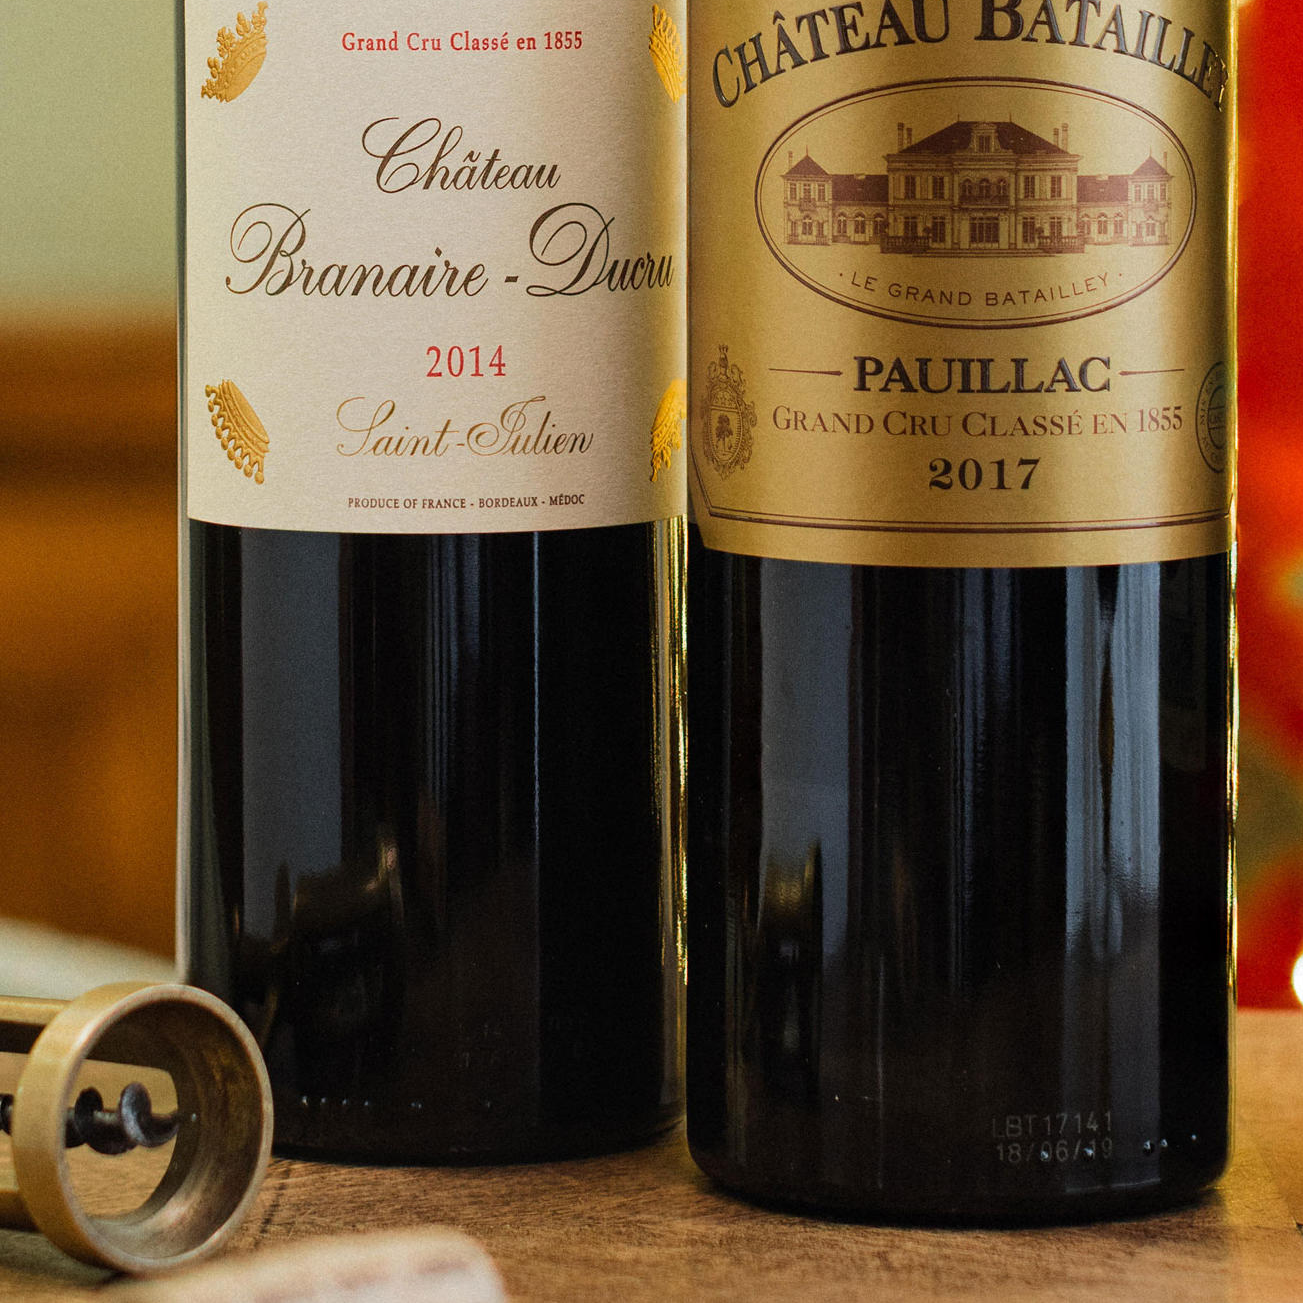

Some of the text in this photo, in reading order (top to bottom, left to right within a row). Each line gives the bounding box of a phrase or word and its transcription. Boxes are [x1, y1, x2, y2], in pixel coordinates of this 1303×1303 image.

[342, 30, 583, 51] Grand Cru Classé en 1855
[362, 117, 561, 193] Château
[225, 203, 489, 297] Branaire
[526, 203, 674, 297] Ducru
[851, 271, 1108, 306] LE GRAND BATAILLEY
[425, 345, 507, 377] 2014
[853, 356, 1112, 394] PAUILLAC
[773, 405, 1183, 437] GRAND CRU CLASSÉ EN 1855
[928, 457, 1041, 490] 2017
[349, 497, 400, 509] PRODUCE
[403, 498, 418, 509] OF
[422, 498, 466, 509] FRANCE
[479, 497, 538, 508] BORDEAUX
[549, 493, 585, 507] MÉDOC
